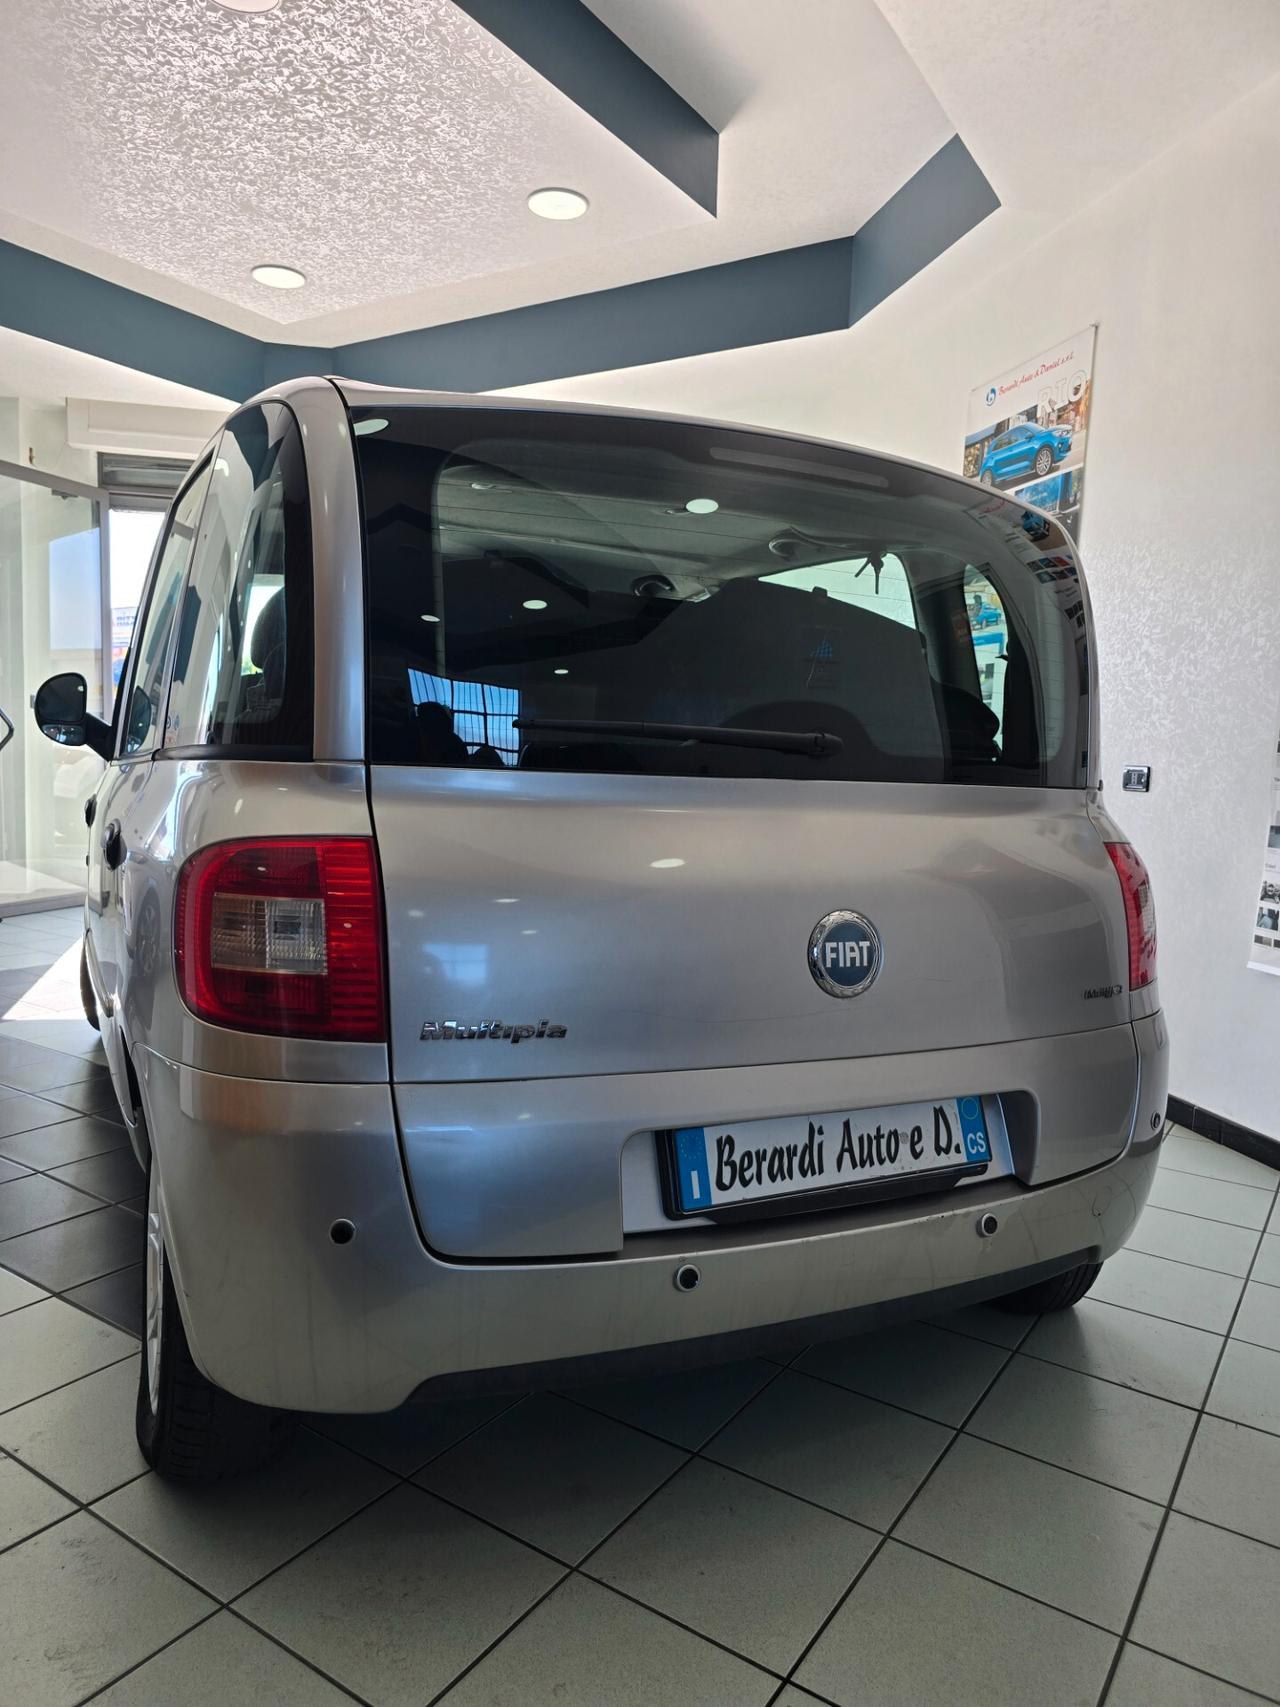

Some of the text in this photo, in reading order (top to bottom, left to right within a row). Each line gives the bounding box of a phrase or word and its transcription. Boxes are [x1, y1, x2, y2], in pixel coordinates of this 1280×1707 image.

[825, 941, 870, 967] FIAT
[420, 1018, 568, 1043] Multipla
[715, 1121, 825, 1191] Berardi
[837, 1118, 900, 1172] Auto
[909, 1125, 923, 1160] e
[933, 1105, 962, 1158] D.
[967, 1131, 986, 1154] CS
